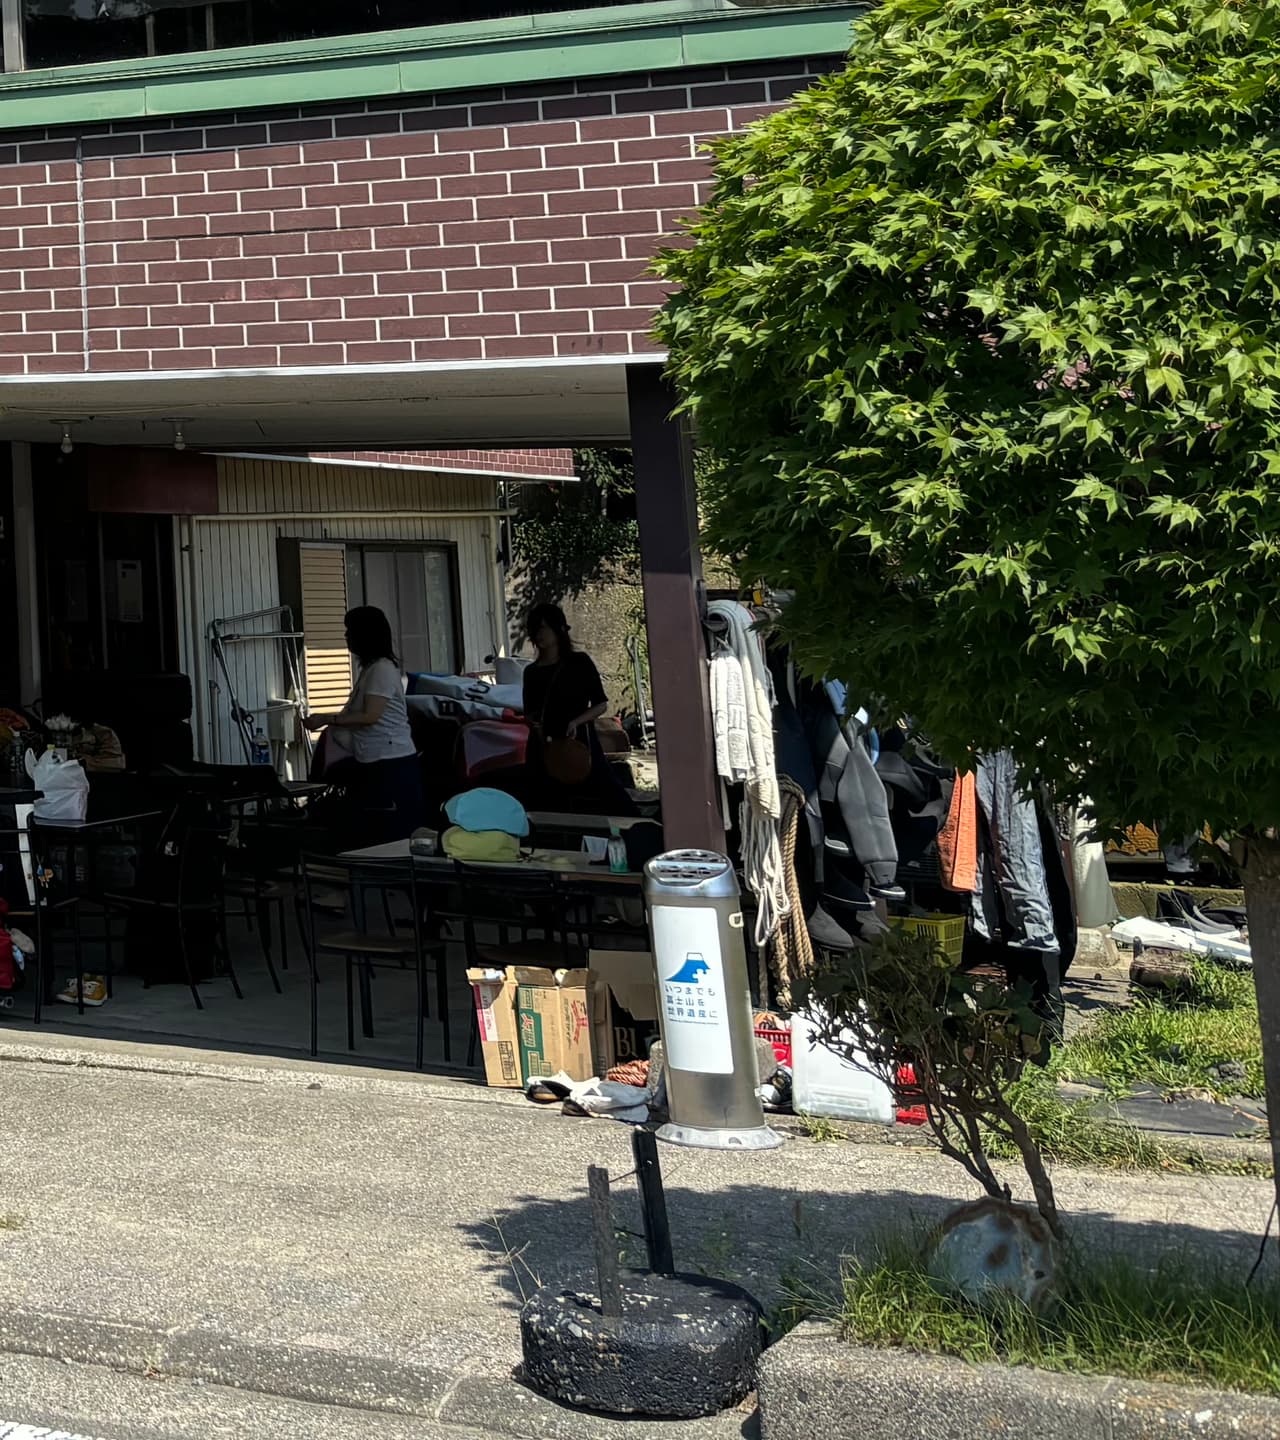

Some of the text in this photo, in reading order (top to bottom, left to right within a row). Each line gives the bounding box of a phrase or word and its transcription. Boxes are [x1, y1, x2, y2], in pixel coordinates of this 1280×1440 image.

[665, 984, 716, 997] いつまでも
[666, 995, 705, 1006] 富士山を
[668, 1007, 718, 1019] 世界遺産に
